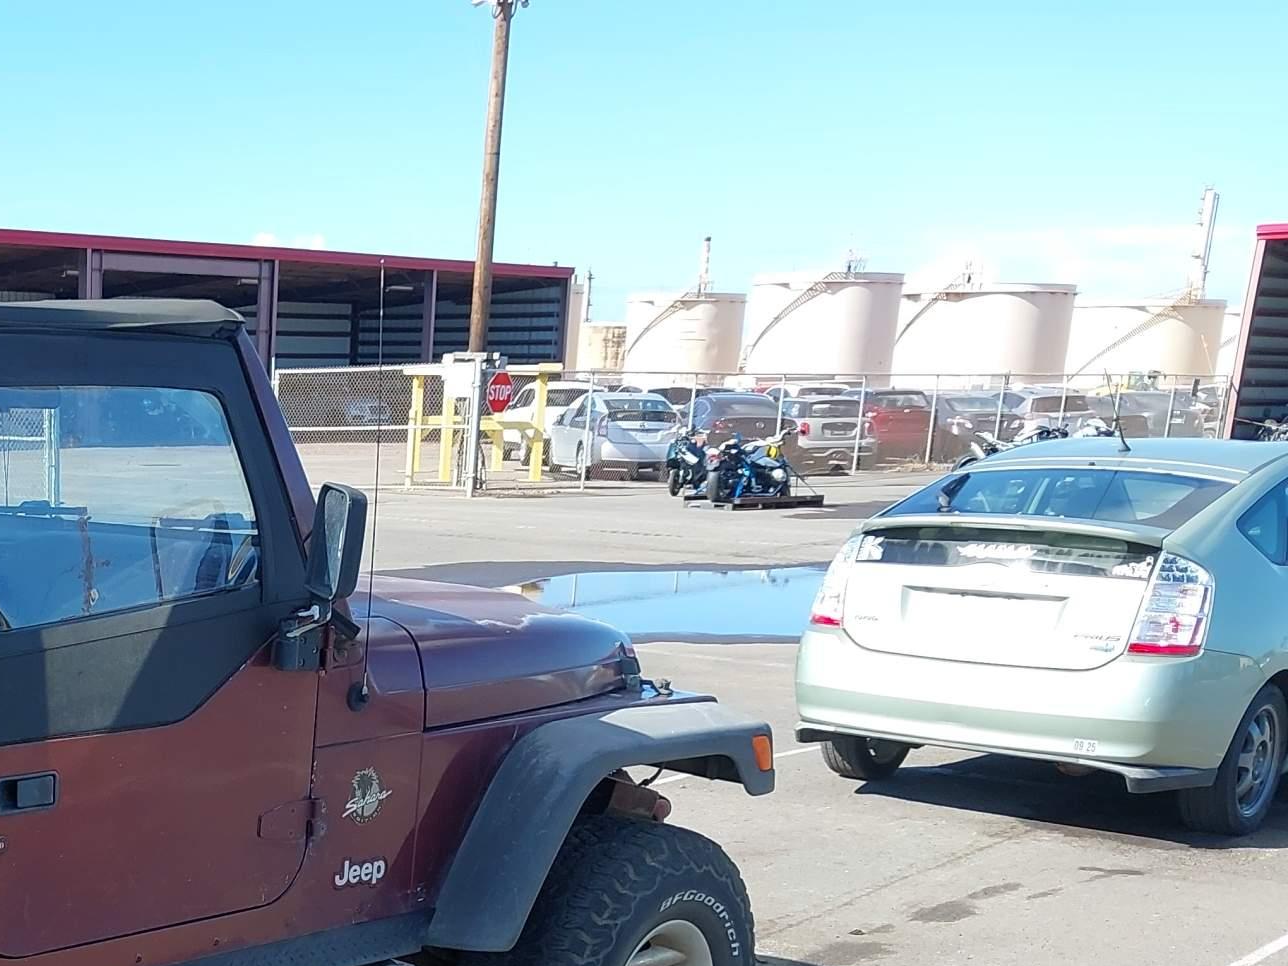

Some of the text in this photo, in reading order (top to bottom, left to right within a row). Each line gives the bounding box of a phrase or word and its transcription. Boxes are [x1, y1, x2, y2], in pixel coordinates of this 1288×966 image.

[489, 385, 512, 401] STOP
[1086, 742, 1096, 753] 25
[342, 789, 393, 818] Sahara
[335, 860, 386, 886] Jeep
[660, 889, 740, 957] BFGoodrich
